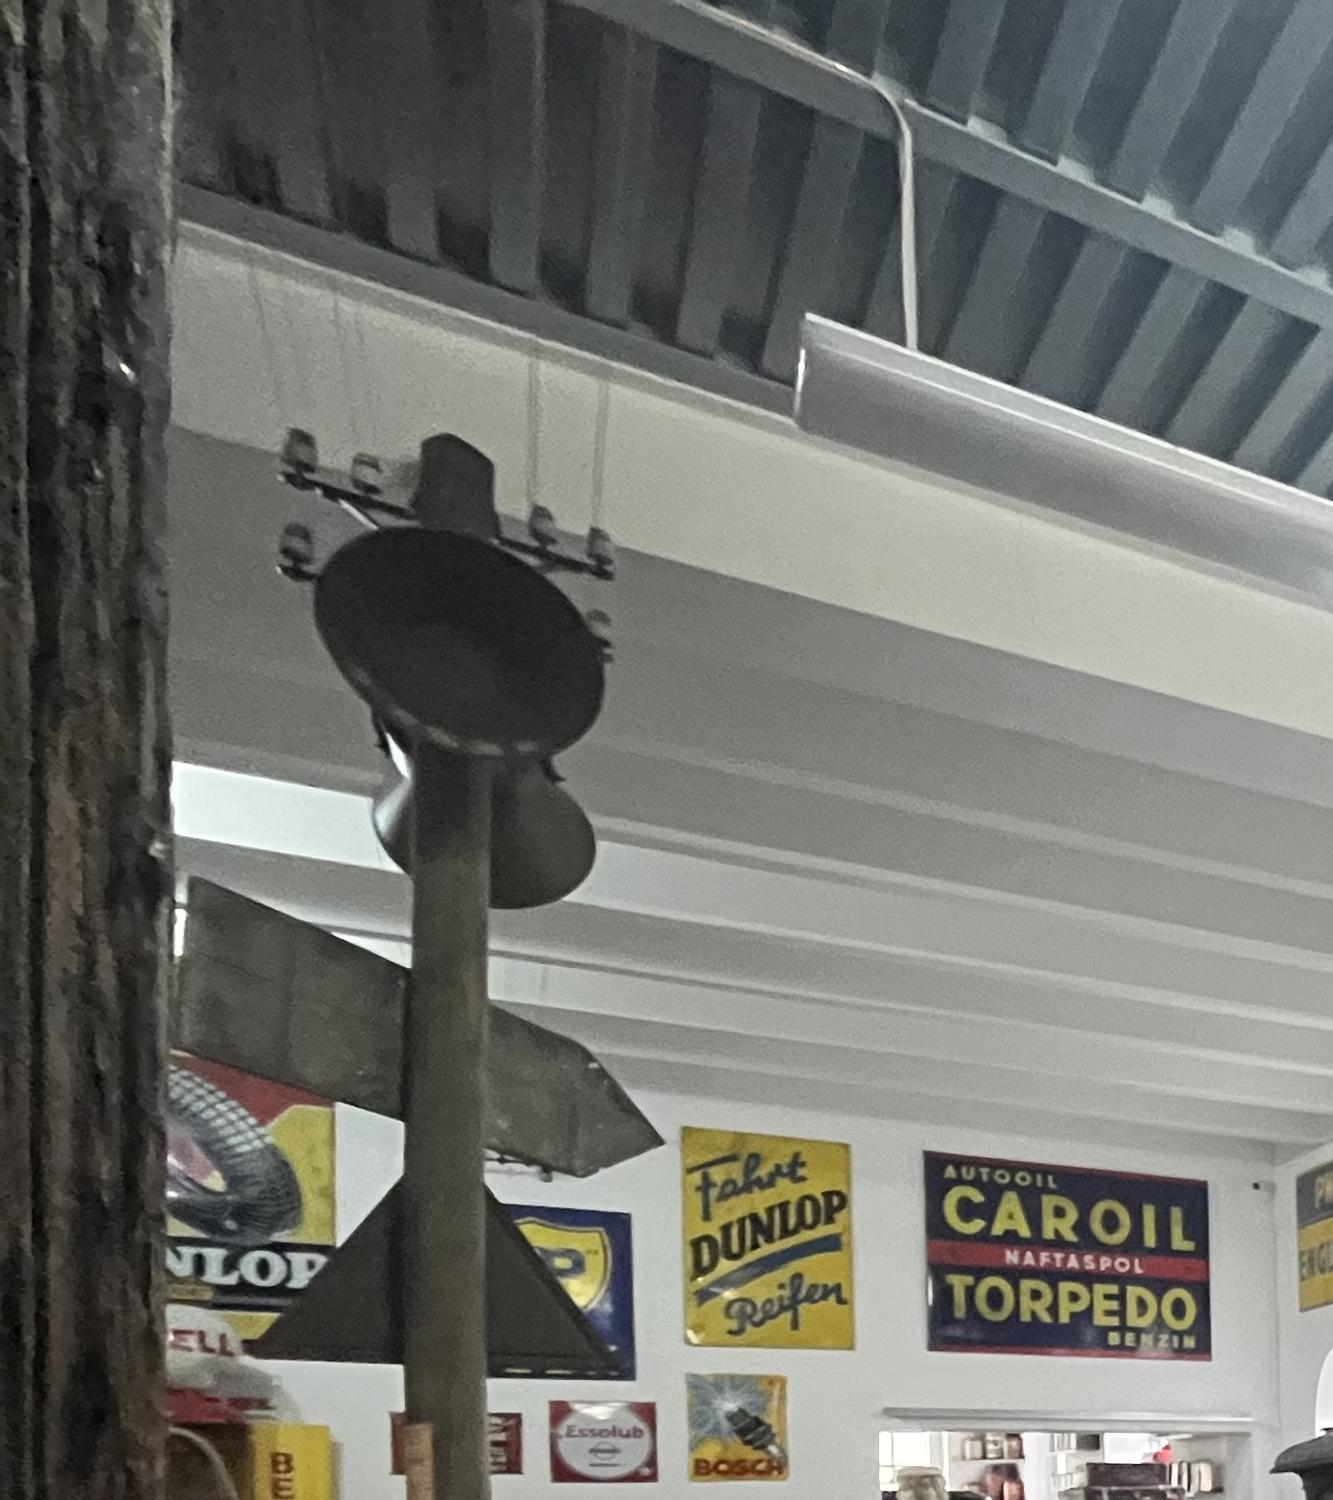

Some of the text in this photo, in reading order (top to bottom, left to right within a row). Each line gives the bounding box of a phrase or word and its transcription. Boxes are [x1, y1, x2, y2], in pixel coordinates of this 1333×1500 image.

[686, 1151, 807, 1221] Fahrt
[942, 1164, 1058, 1190] AUTOOIL
[690, 1189, 847, 1280] DUNLOP
[942, 1185, 1197, 1252] CAROIL
[1004, 1249, 1144, 1275] NAFTASPOL
[725, 1271, 848, 1337] Reifen
[945, 1273, 1198, 1331] TORPEDO
[1107, 1331, 1196, 1350] BENZIN
[565, 1424, 645, 1439] Essolub
[693, 1457, 785, 1476] BOSCH
